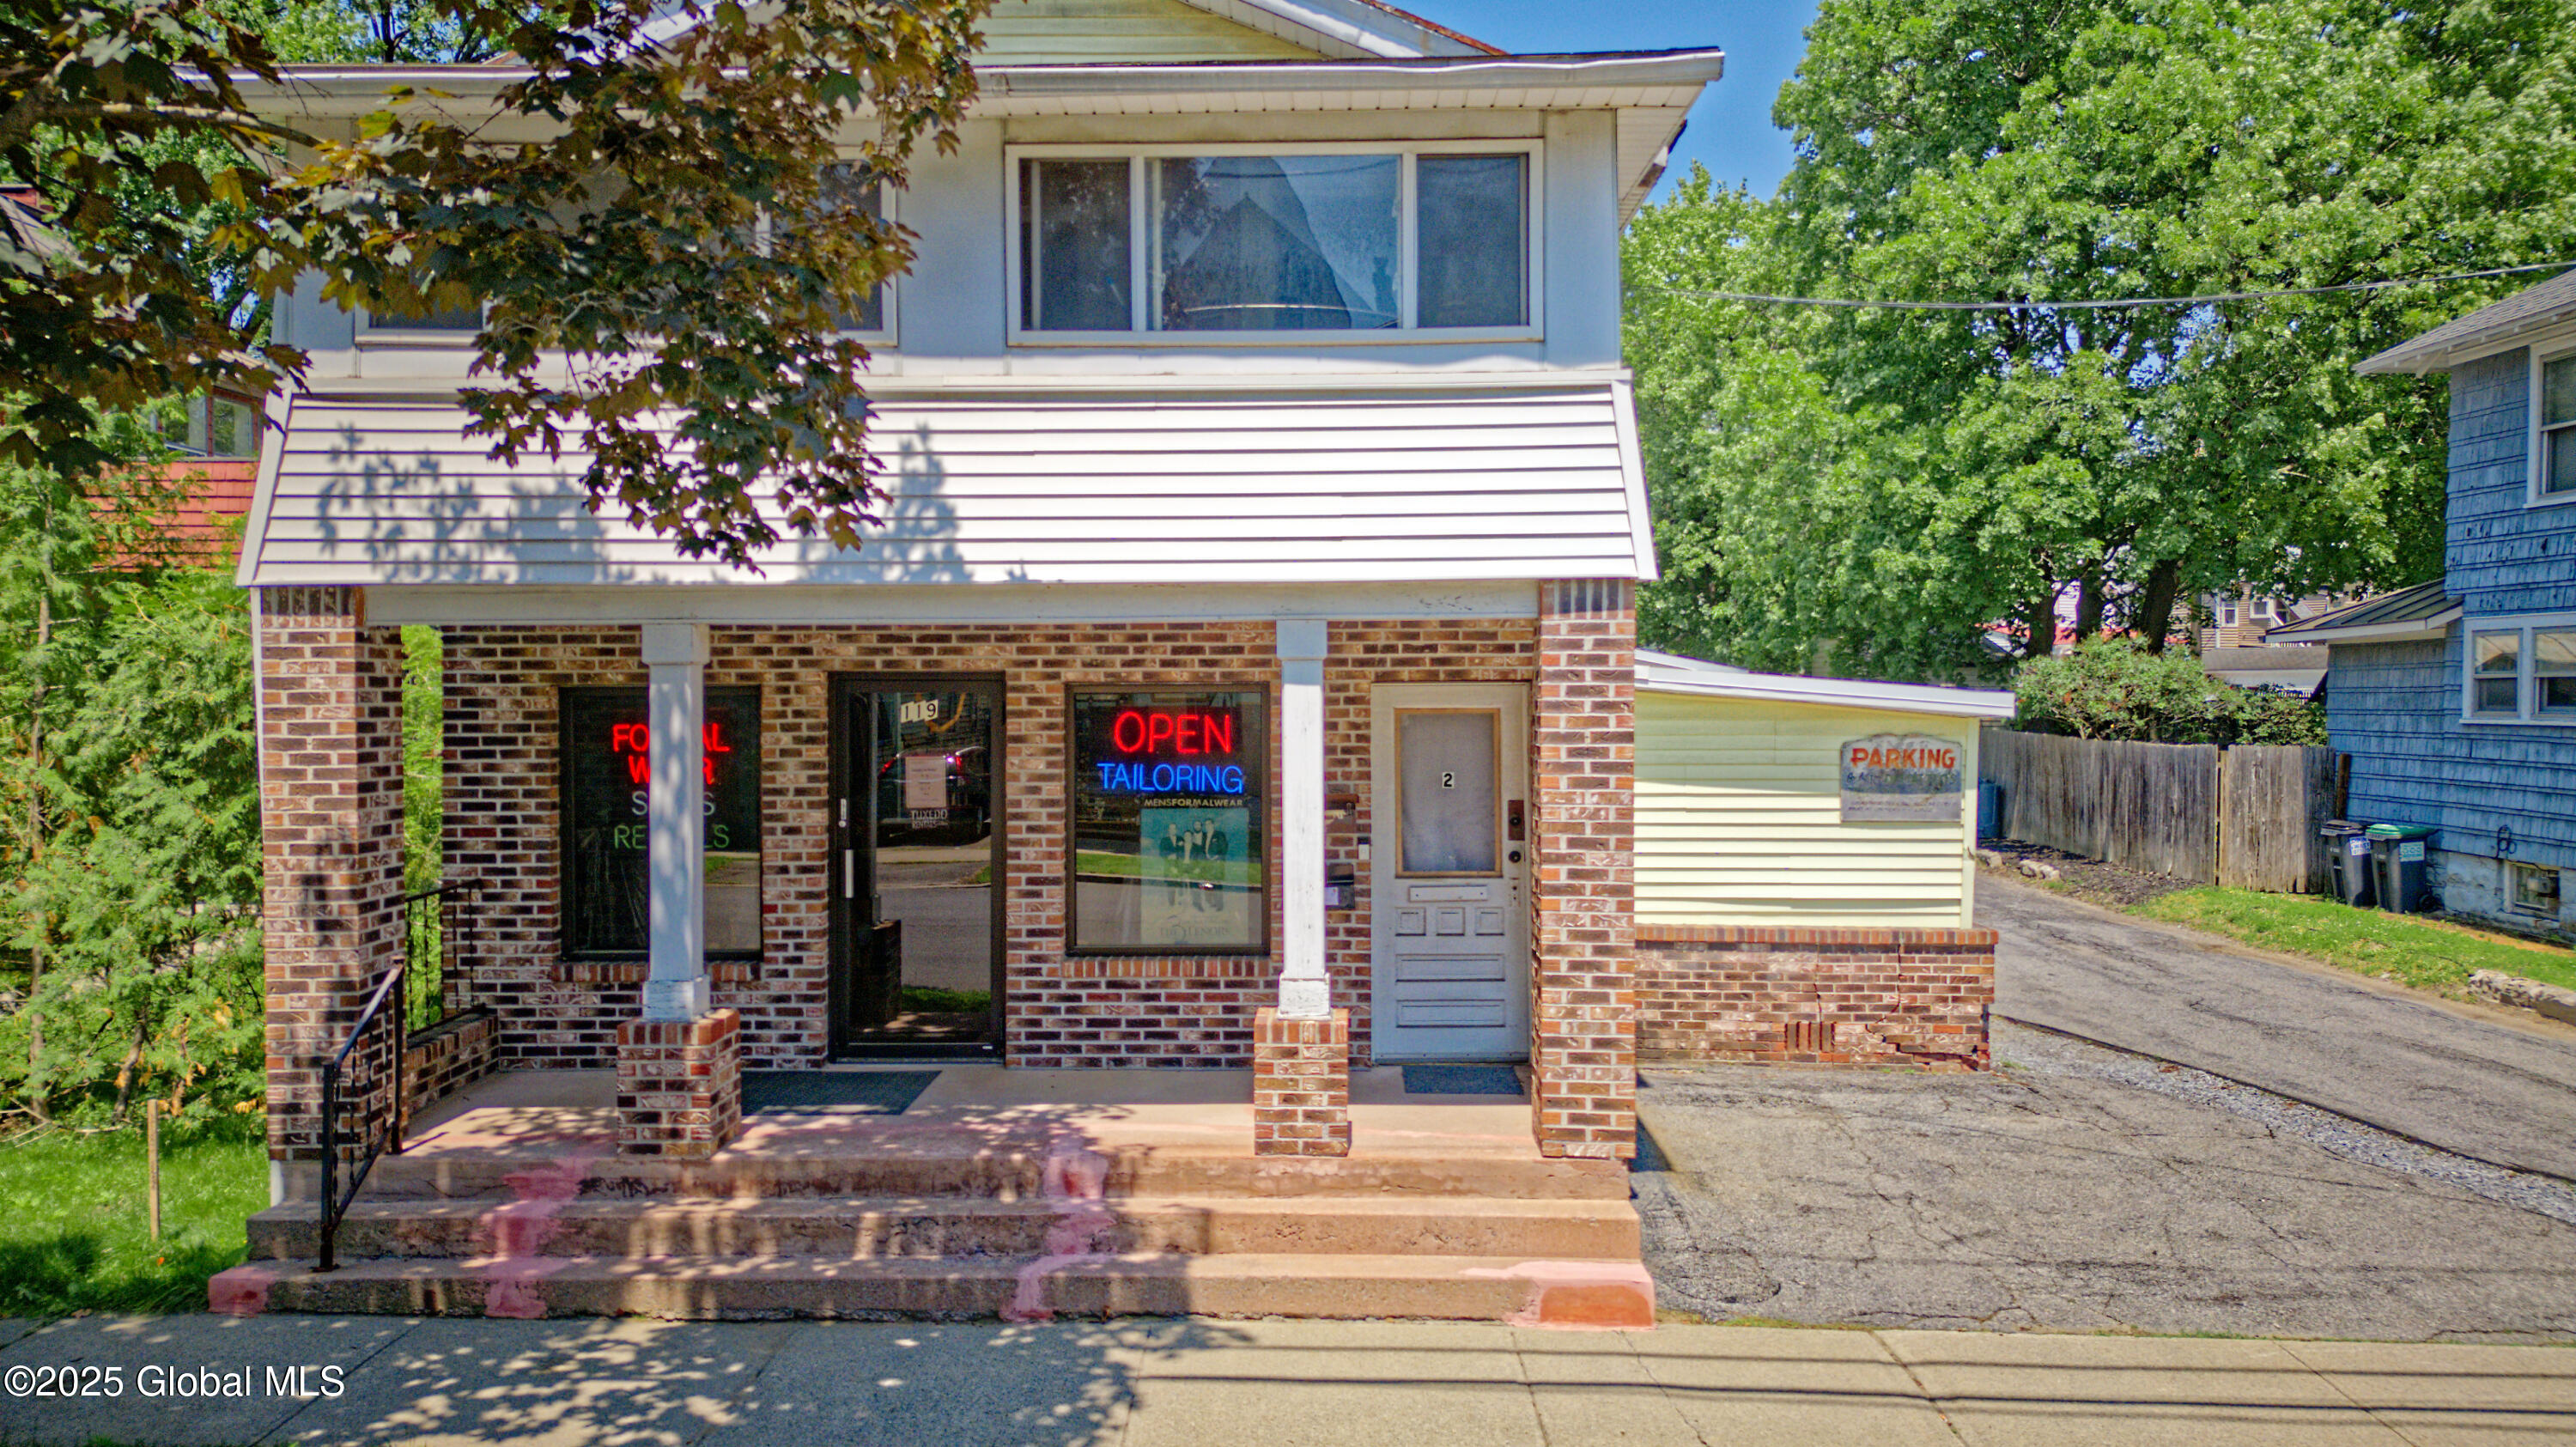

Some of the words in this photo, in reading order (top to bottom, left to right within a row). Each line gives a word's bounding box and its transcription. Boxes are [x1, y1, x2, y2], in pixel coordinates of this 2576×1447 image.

[906, 703, 936, 720] 119
[1114, 711, 1231, 754] OPEN
[1850, 748, 1956, 769] PARKING
[1097, 763, 1243, 793] TAILORING
[1443, 774, 1452, 787] 2
[911, 809, 948, 820] TUXEDO
